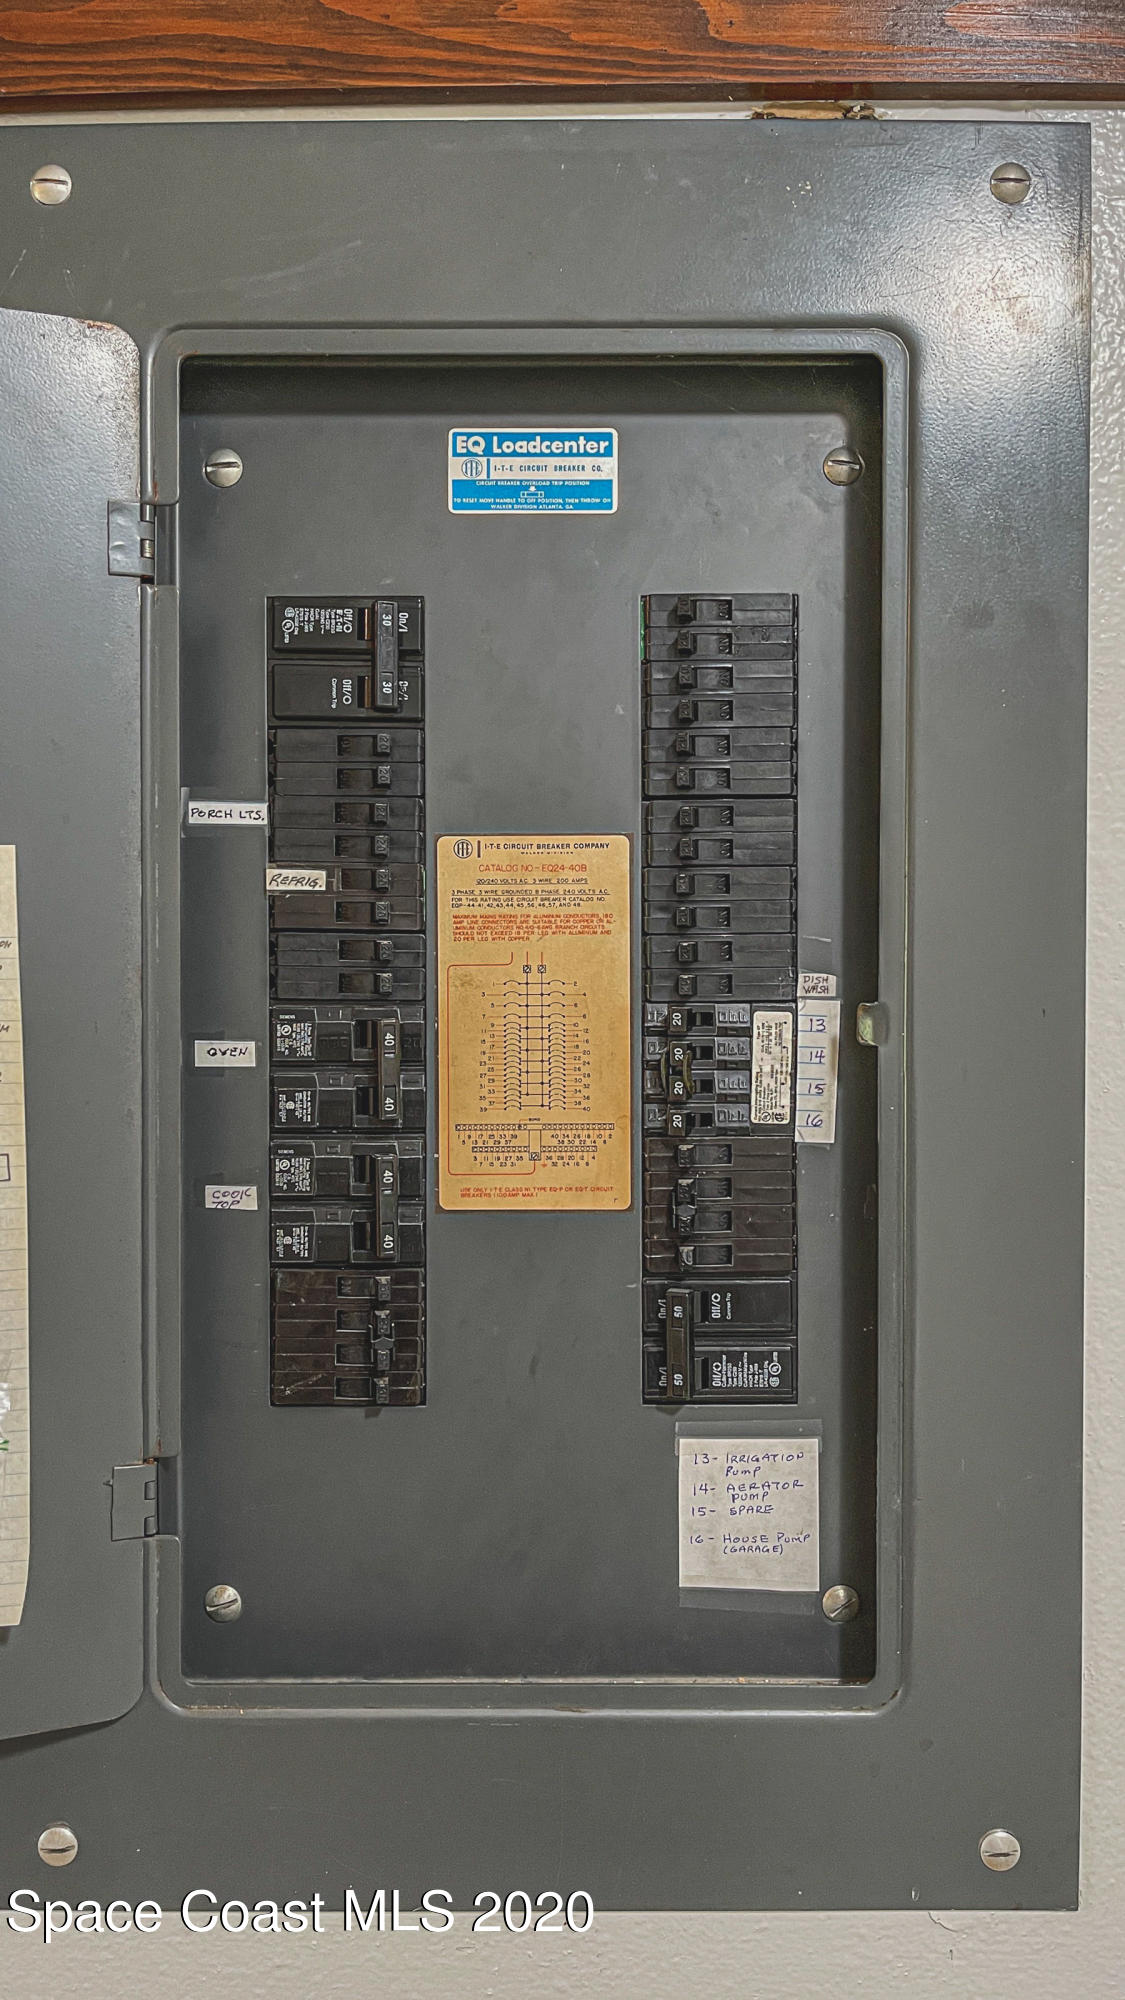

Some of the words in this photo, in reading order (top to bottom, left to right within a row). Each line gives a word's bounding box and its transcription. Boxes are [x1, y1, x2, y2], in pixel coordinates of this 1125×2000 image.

[456, 436, 485, 455] EQ
[493, 436, 609, 453] Loadcenter
[382, 614, 392, 626] 30
[382, 681, 392, 693] 30
[191, 808, 232, 818] PORCH
[240, 811, 264, 821] LTS.
[269, 874, 322, 889] REFRIG.
[803, 976, 829, 984] DISH
[803, 985, 829, 994] WASH
[673, 1013, 682, 1025] 20
[810, 1019, 826, 1032] 13
[384, 1033, 394, 1046] 40
[207, 1047, 248, 1057] OVEN
[674, 1048, 682, 1060] 20
[809, 1050, 825, 1064] 14
[674, 1082, 684, 1094] 20
[808, 1084, 826, 1094] 15
[384, 1098, 394, 1111] 40
[673, 1115, 682, 1127] 20
[806, 1114, 823, 1127] 16
[383, 1170, 393, 1183] 40
[212, 1188, 252, 1200] COOK
[212, 1200, 240, 1209] TOP
[383, 1235, 393, 1248] 40
[674, 1306, 683, 1318] 50
[674, 1374, 683, 1386] 50
[726, 1452, 804, 1464] IRRIGATION
[726, 1480, 804, 1492] AERATOR
[730, 1505, 774, 1515] SPARE
[723, 1546, 783, 1555] (GARAGE)
